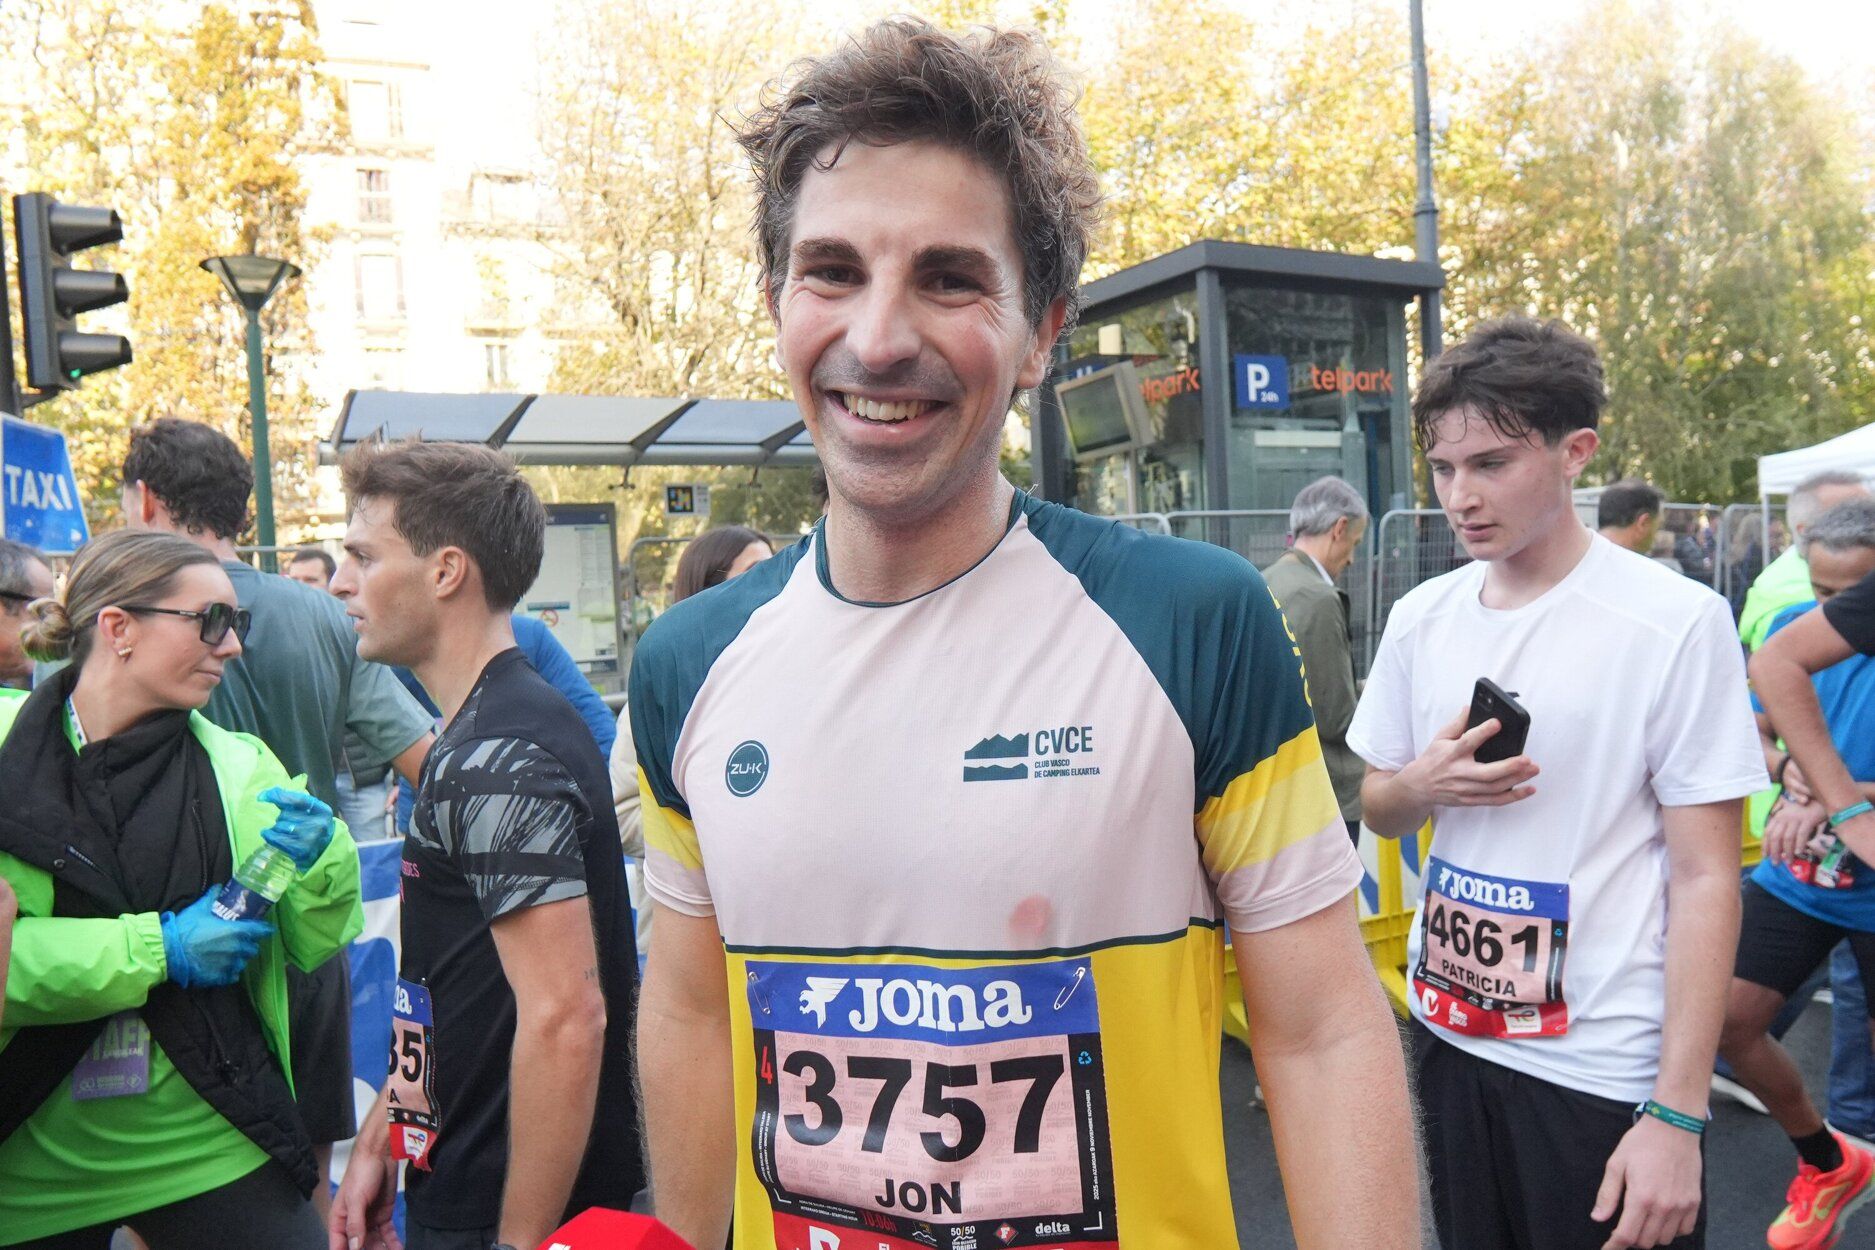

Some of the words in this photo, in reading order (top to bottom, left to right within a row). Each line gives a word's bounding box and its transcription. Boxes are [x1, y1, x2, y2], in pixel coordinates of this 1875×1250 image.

[1247, 363, 1270, 402] P
[1311, 363, 1393, 397] telpark
[5, 464, 73, 511] TAXI
[1035, 726, 1093, 756] CVCE
[1034, 759, 1050, 769] CLUB
[1051, 759, 1070, 767] VASCO
[1034, 770, 1043, 779] DE
[1043, 768, 1070, 778] CAMPING
[1071, 767, 1101, 776] ELKARTEA
[1429, 903, 1539, 973] 4661
[1442, 959, 1517, 997] PATRICIA
[760, 1046, 773, 1084] 4
[782, 1050, 1064, 1163] 3757
[1085, 1089, 1093, 1117] NOVEMBER
[875, 1178, 962, 1215] JON
[950, 1225, 975, 1238] 50/50
[1035, 1221, 1071, 1234] delta
